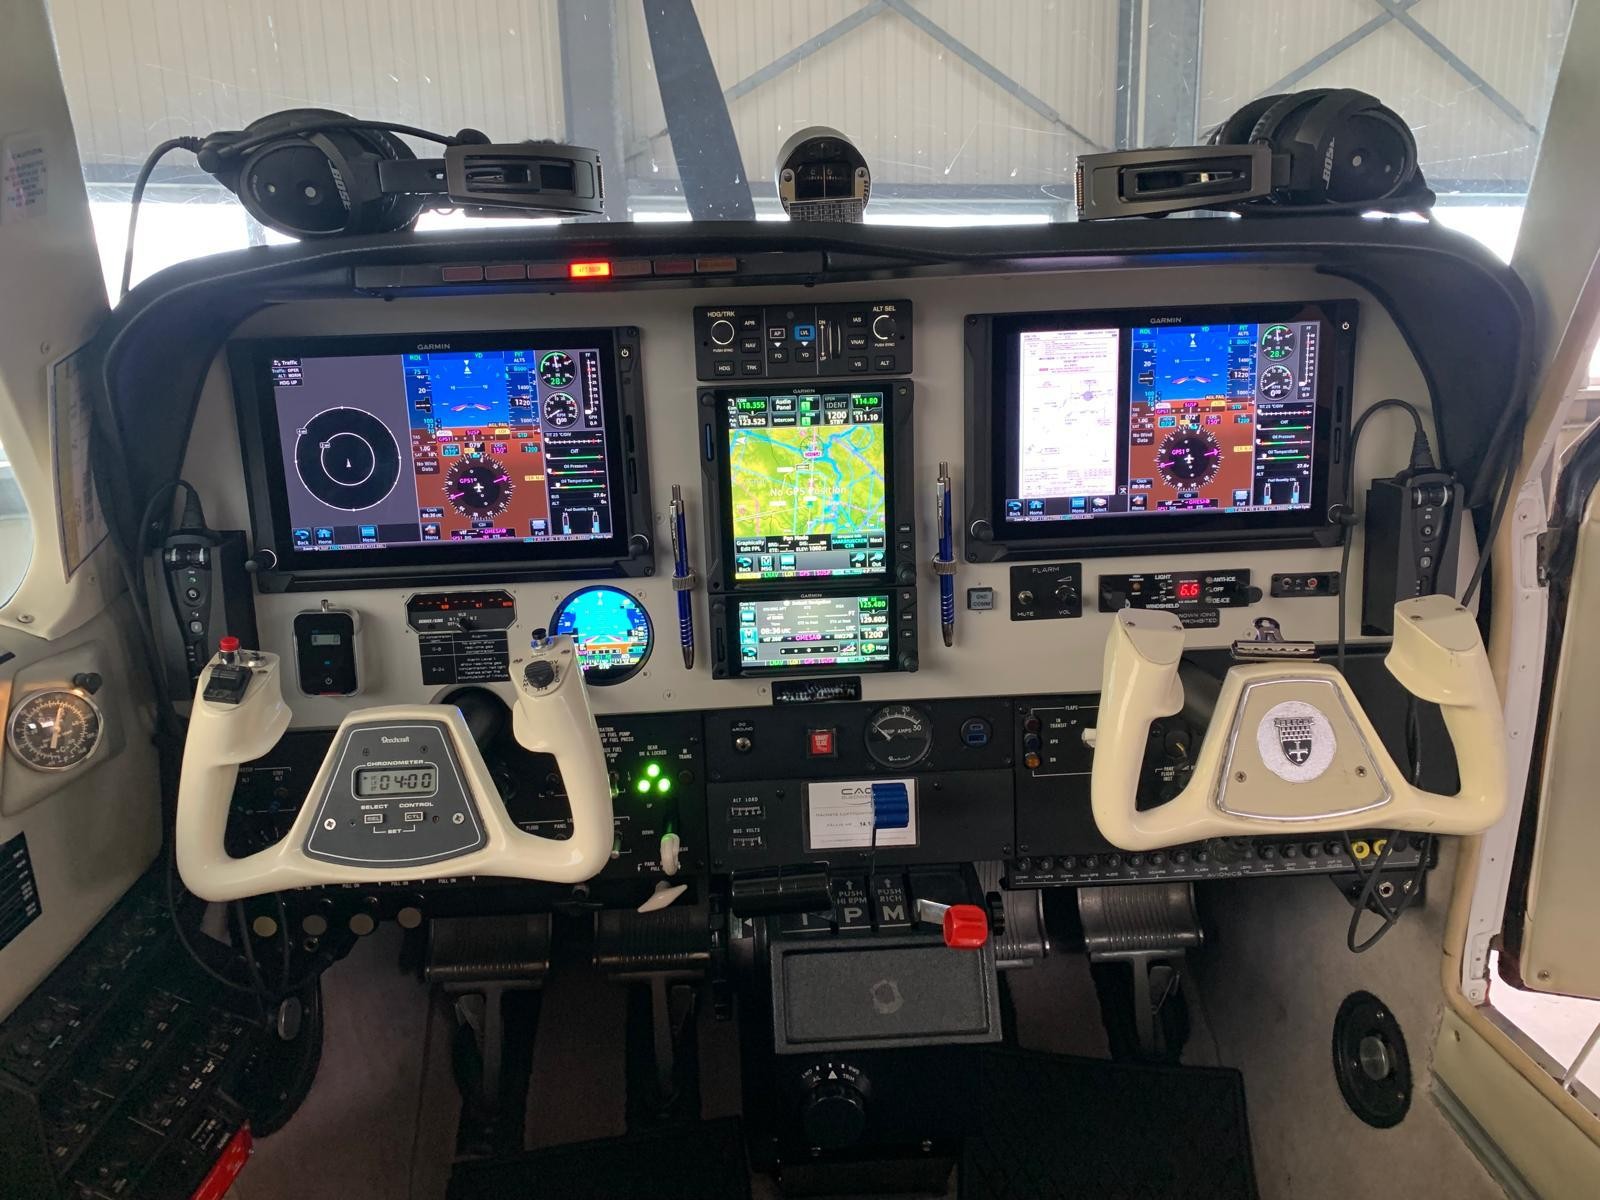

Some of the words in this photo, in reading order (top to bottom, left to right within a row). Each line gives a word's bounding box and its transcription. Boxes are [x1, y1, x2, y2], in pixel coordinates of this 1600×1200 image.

[827, 410, 848, 420] 1200
[856, 414, 879, 422] 111.10
[1032, 566, 1060, 574] FLARM
[864, 631, 885, 640] 1200
[380, 773, 432, 790] 04:00
[1207, 870, 1242, 878] AVIONICS
[877, 888, 902, 896] PUSH
[844, 907, 862, 923] P
[882, 905, 905, 920] M
